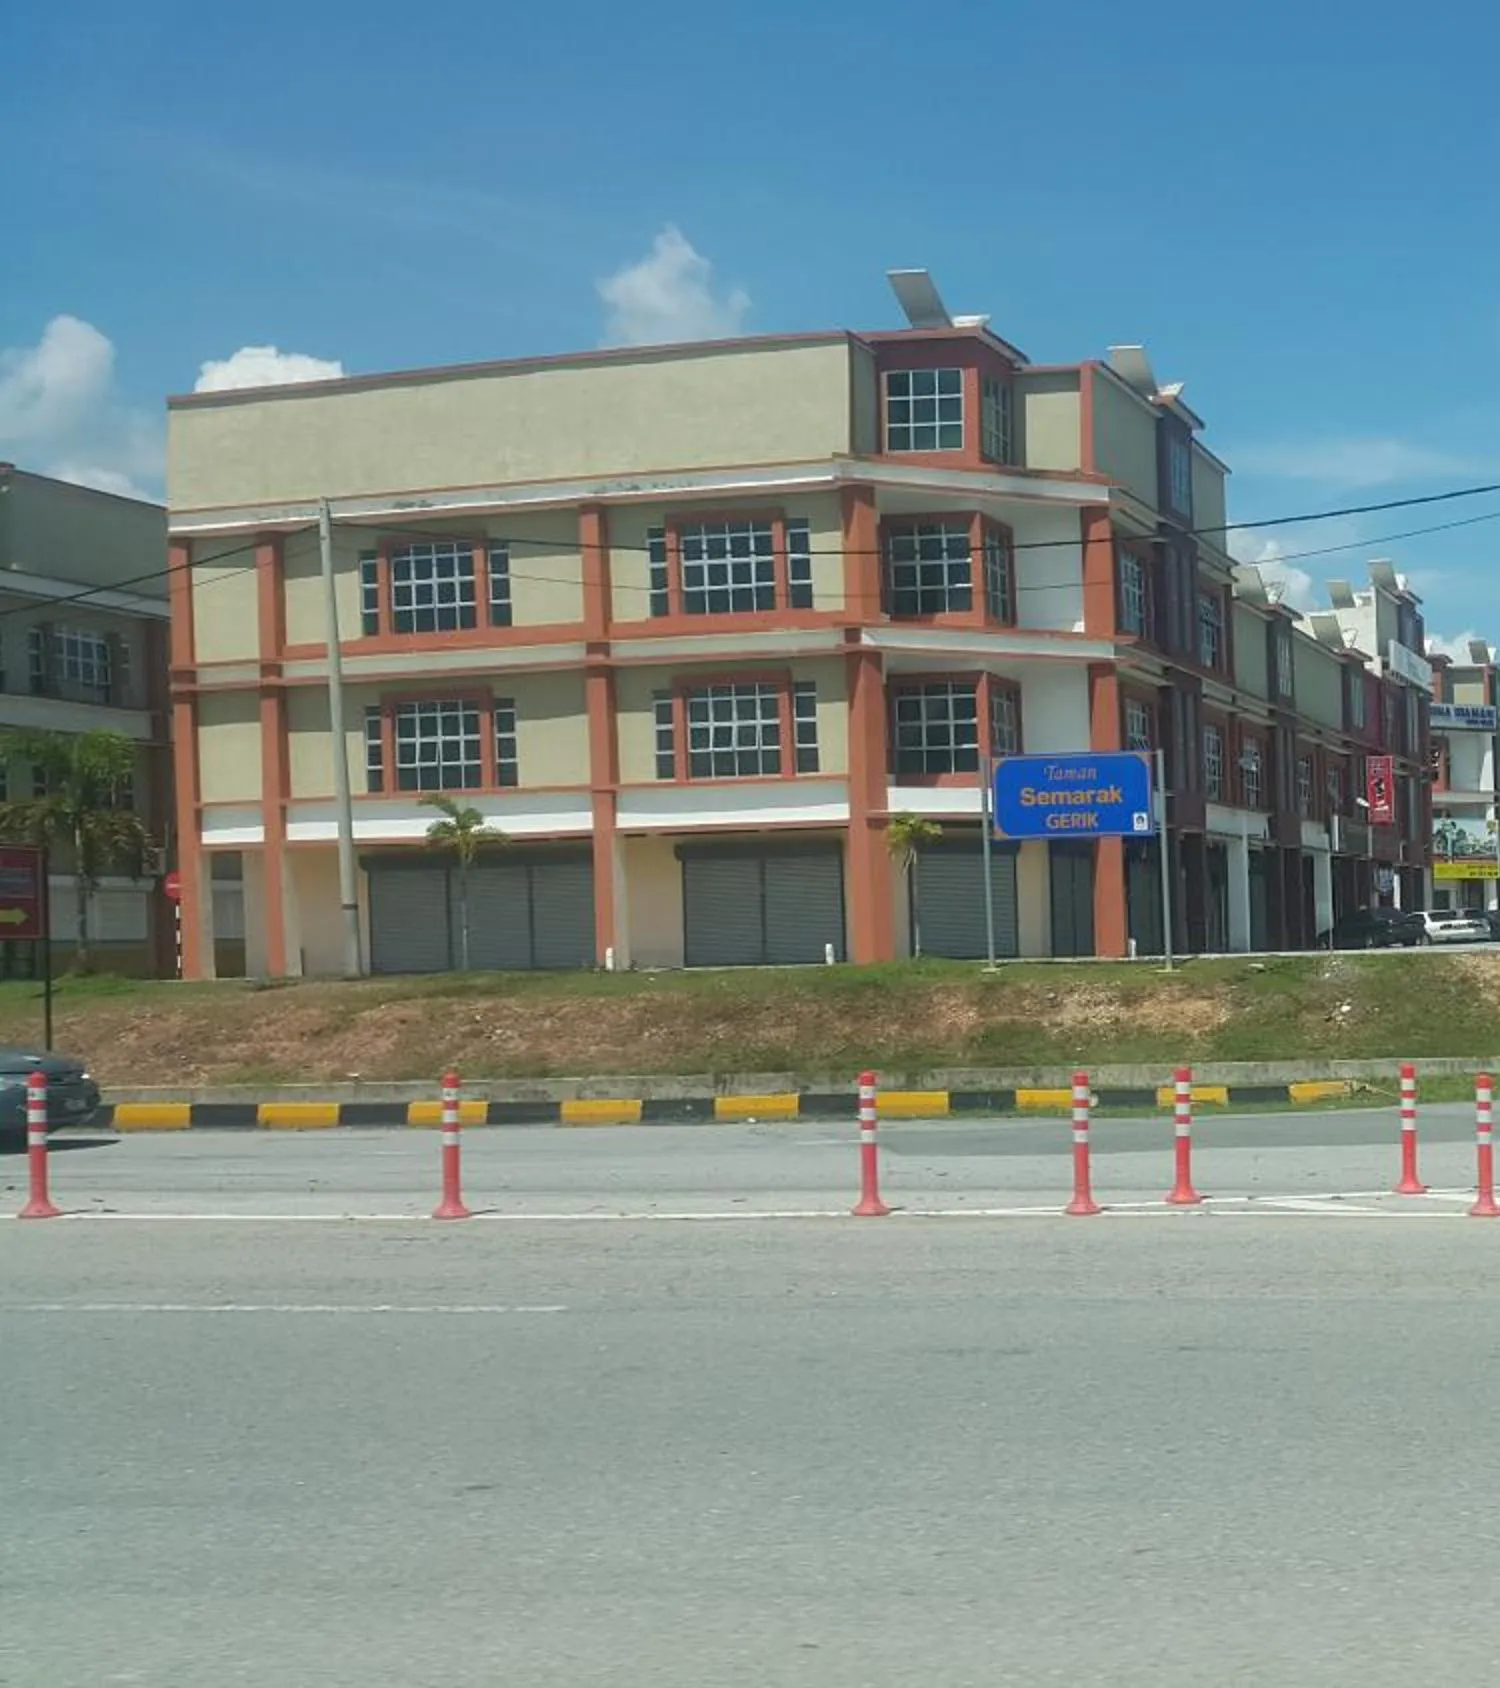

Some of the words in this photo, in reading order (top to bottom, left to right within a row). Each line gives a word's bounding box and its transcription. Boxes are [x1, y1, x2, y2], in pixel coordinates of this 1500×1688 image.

[1044, 764, 1097, 781] Taman
[1020, 785, 1122, 806] Semarak
[1046, 812, 1098, 829] GERIK
